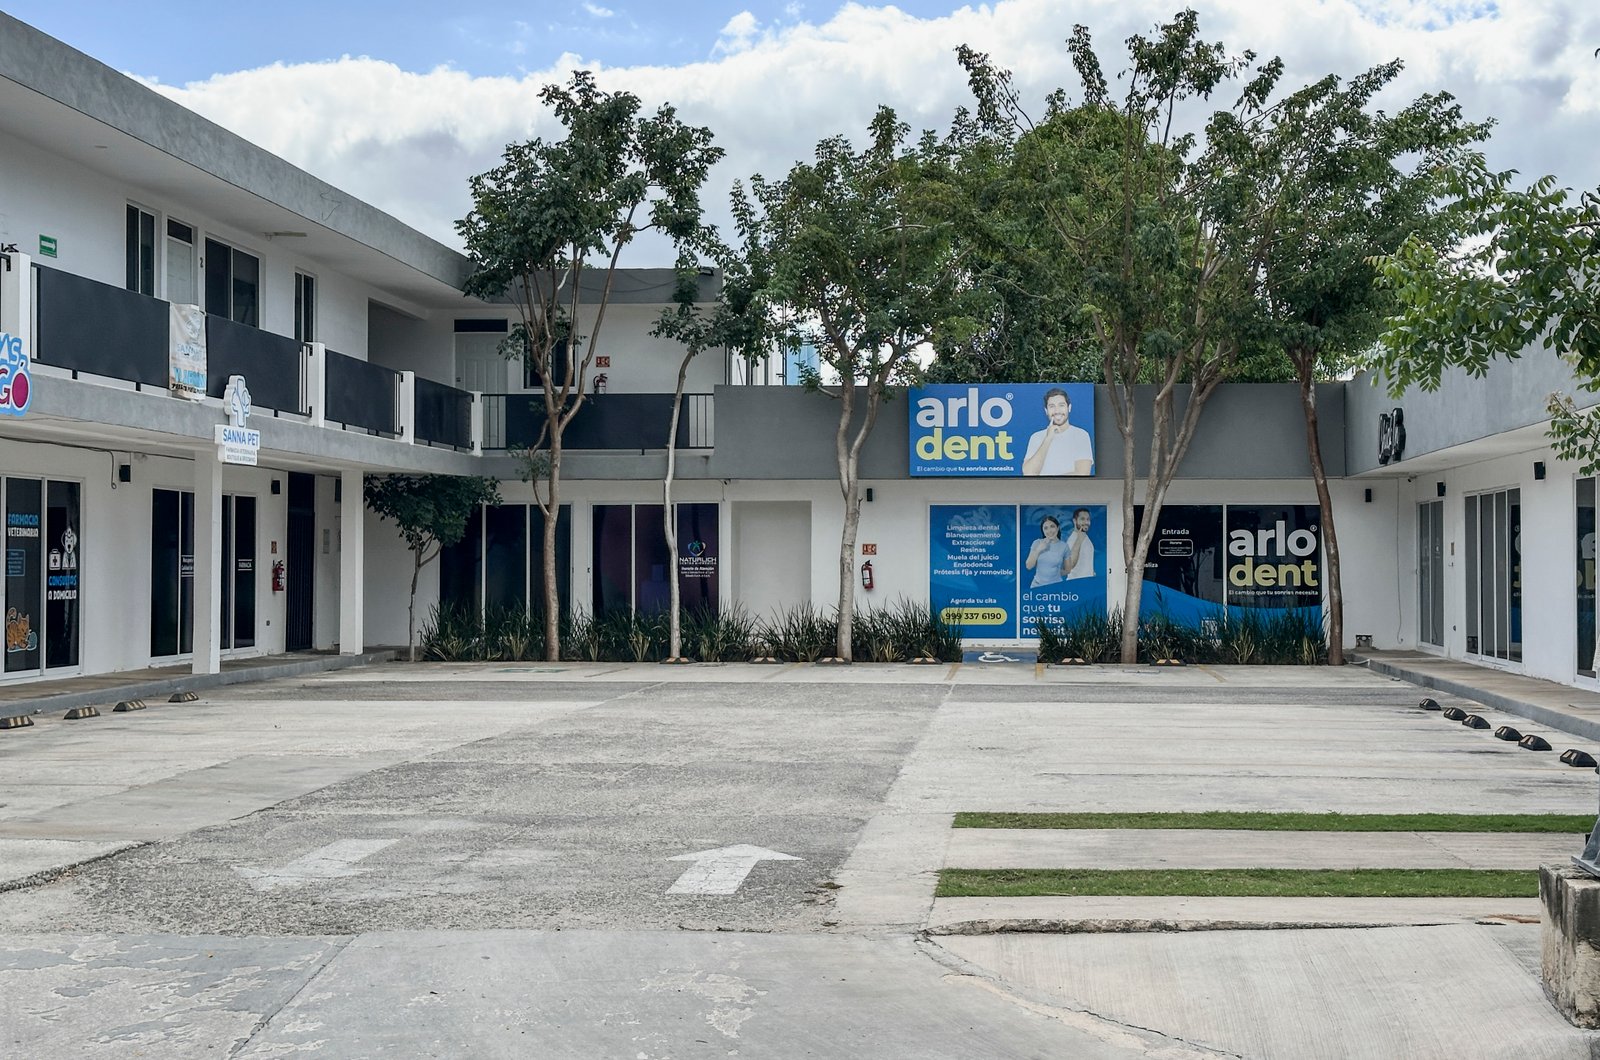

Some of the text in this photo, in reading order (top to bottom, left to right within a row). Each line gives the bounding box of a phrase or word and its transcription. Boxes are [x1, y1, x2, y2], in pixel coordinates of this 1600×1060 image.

[223, 429, 259, 446] SANNA PET
[916, 428, 1014, 461] dent
[8, 513, 39, 525] FARMACIA
[1229, 557, 1318, 587] dent
[48, 590, 77, 600] A DOMICILIO
[1022, 591, 1079, 602] el cambio
[1022, 603, 1061, 614] que tu
[945, 612, 1002, 620] 999 337 6190
